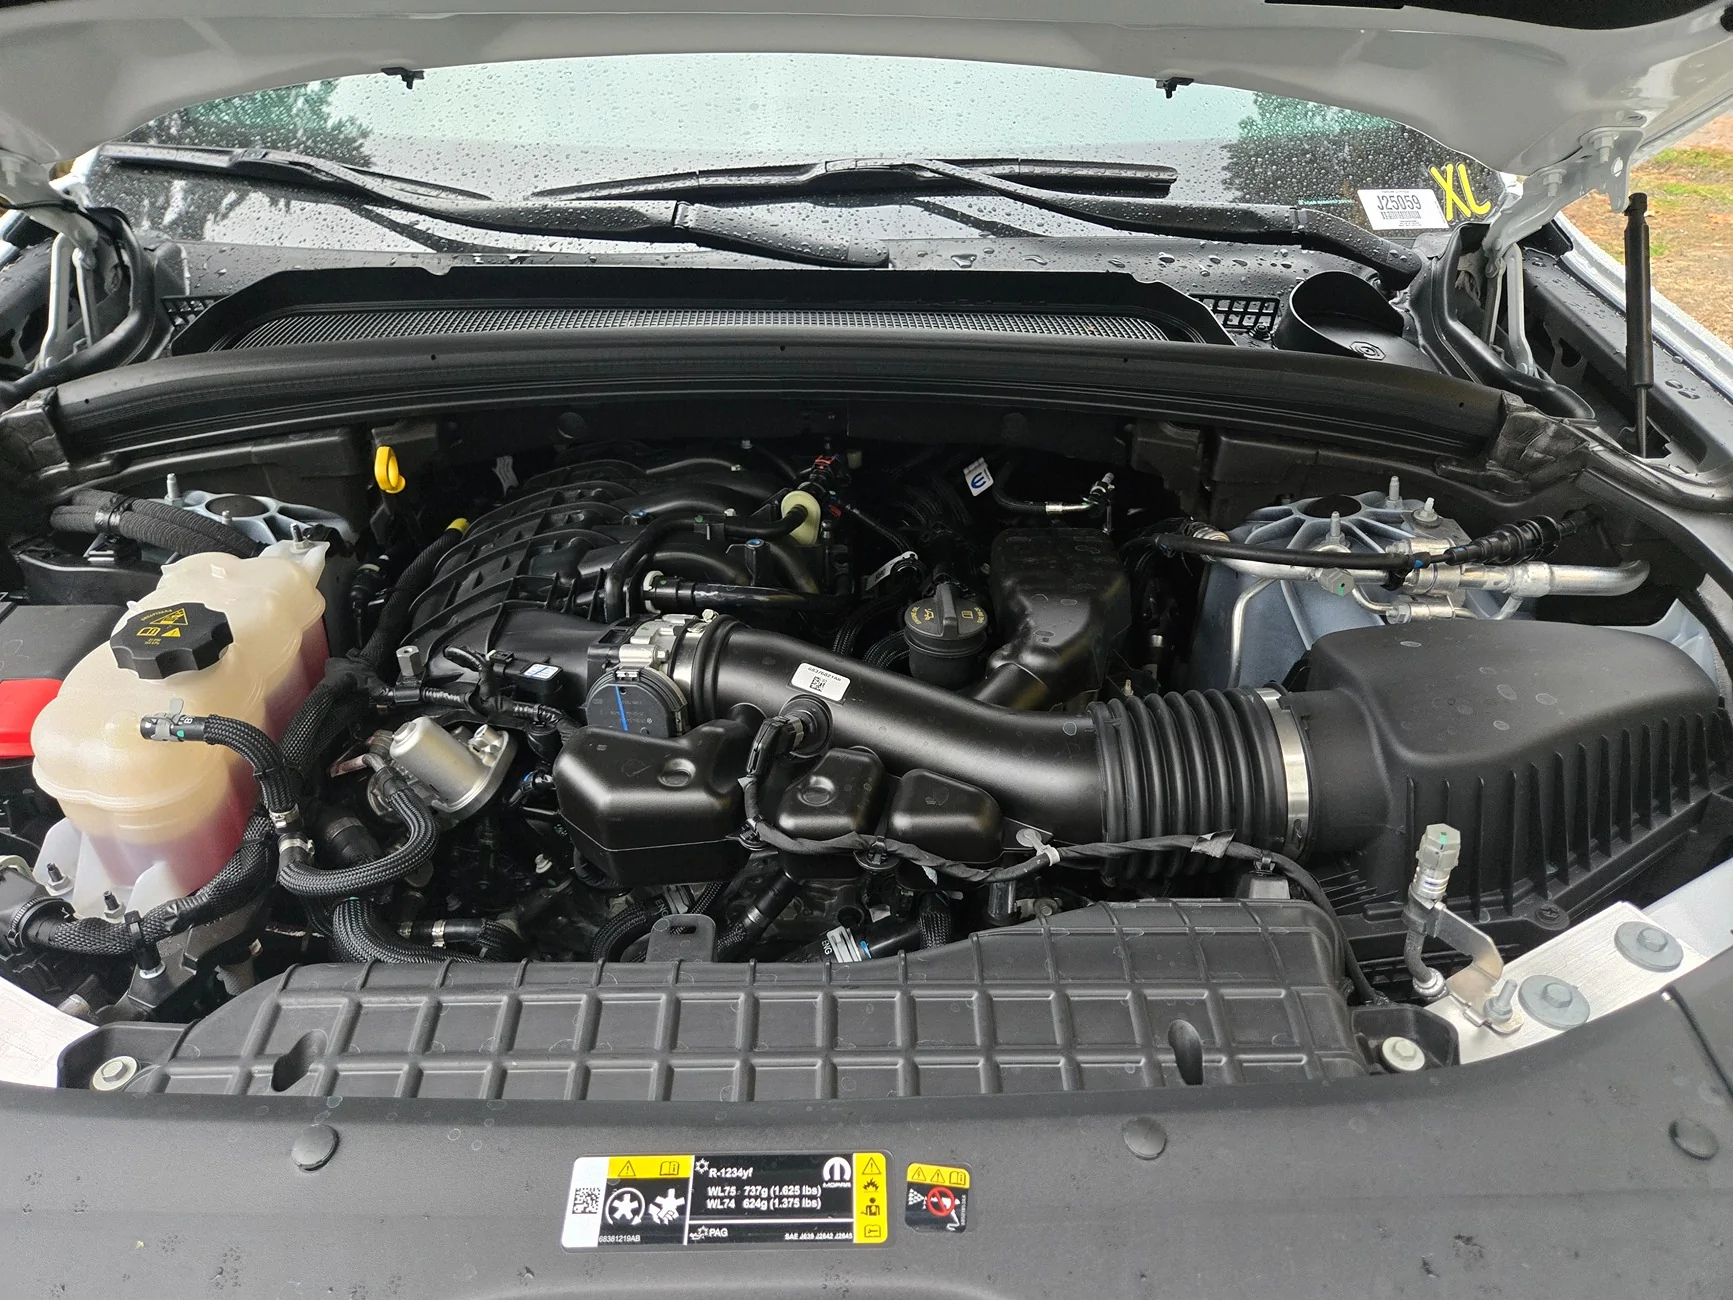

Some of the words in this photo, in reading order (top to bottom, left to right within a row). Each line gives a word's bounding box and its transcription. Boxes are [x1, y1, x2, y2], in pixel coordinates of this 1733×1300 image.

[1430, 163, 1492, 221] XL
[1376, 194, 1422, 211] J25059
[821, 939, 833, 955] ENG
[708, 1166, 754, 1180] R-1234yf
[707, 1185, 737, 1197] WL75
[743, 1185, 769, 1198] 737g
[770, 1185, 801, 1198] (1.625
[802, 1184, 822, 1198] lbs)
[706, 1198, 736, 1209] WL74
[743, 1197, 768, 1210] 624g
[769, 1197, 801, 1211] (1.375
[802, 1197, 822, 1210] lbs)
[708, 1227, 729, 1238] PAG
